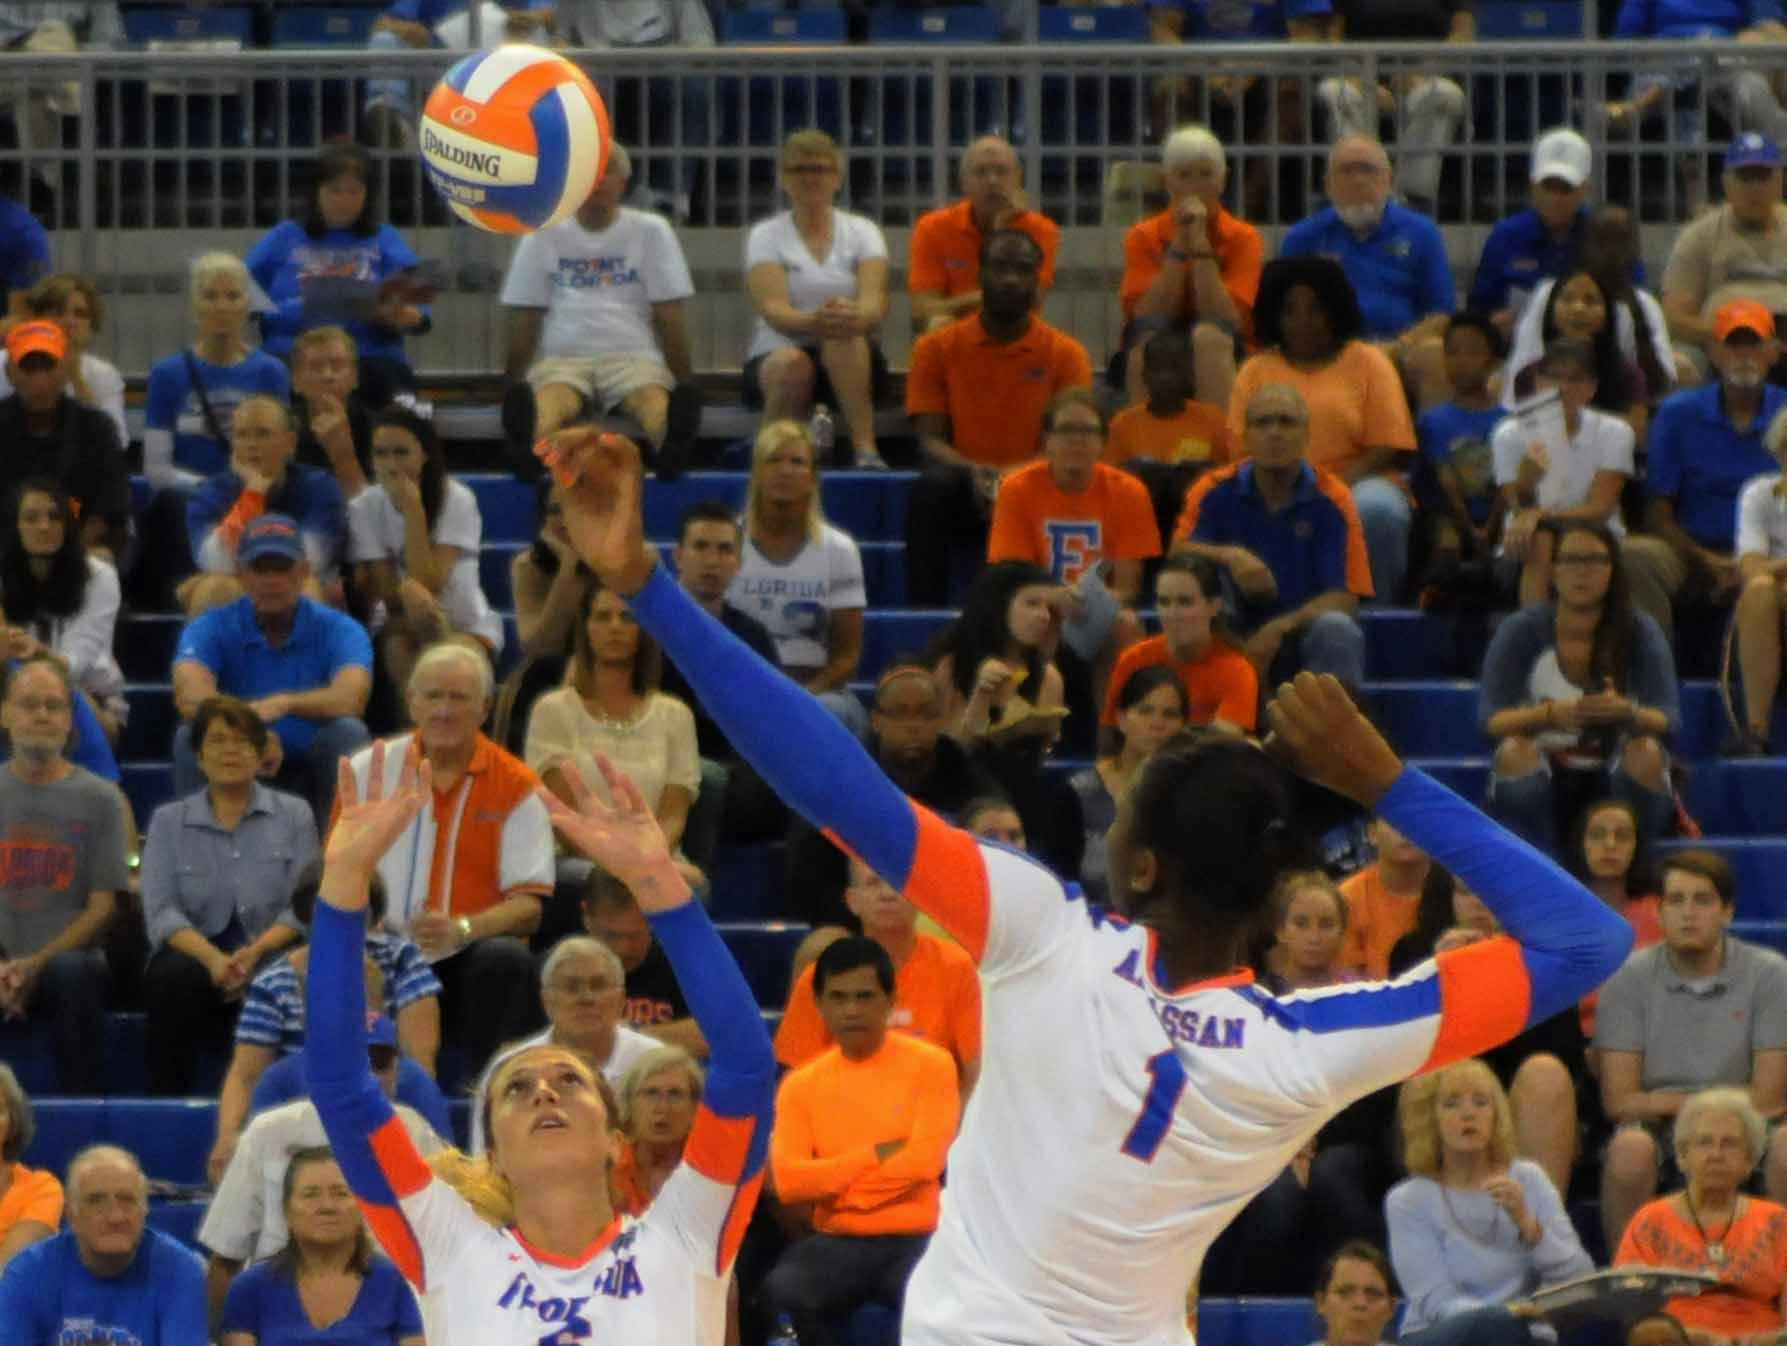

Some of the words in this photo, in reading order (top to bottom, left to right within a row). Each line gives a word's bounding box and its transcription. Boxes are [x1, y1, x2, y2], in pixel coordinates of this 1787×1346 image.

[424, 128, 502, 178] SPALDING
[1045, 520, 1102, 589] F
[1120, 1047, 1188, 1166] 1
